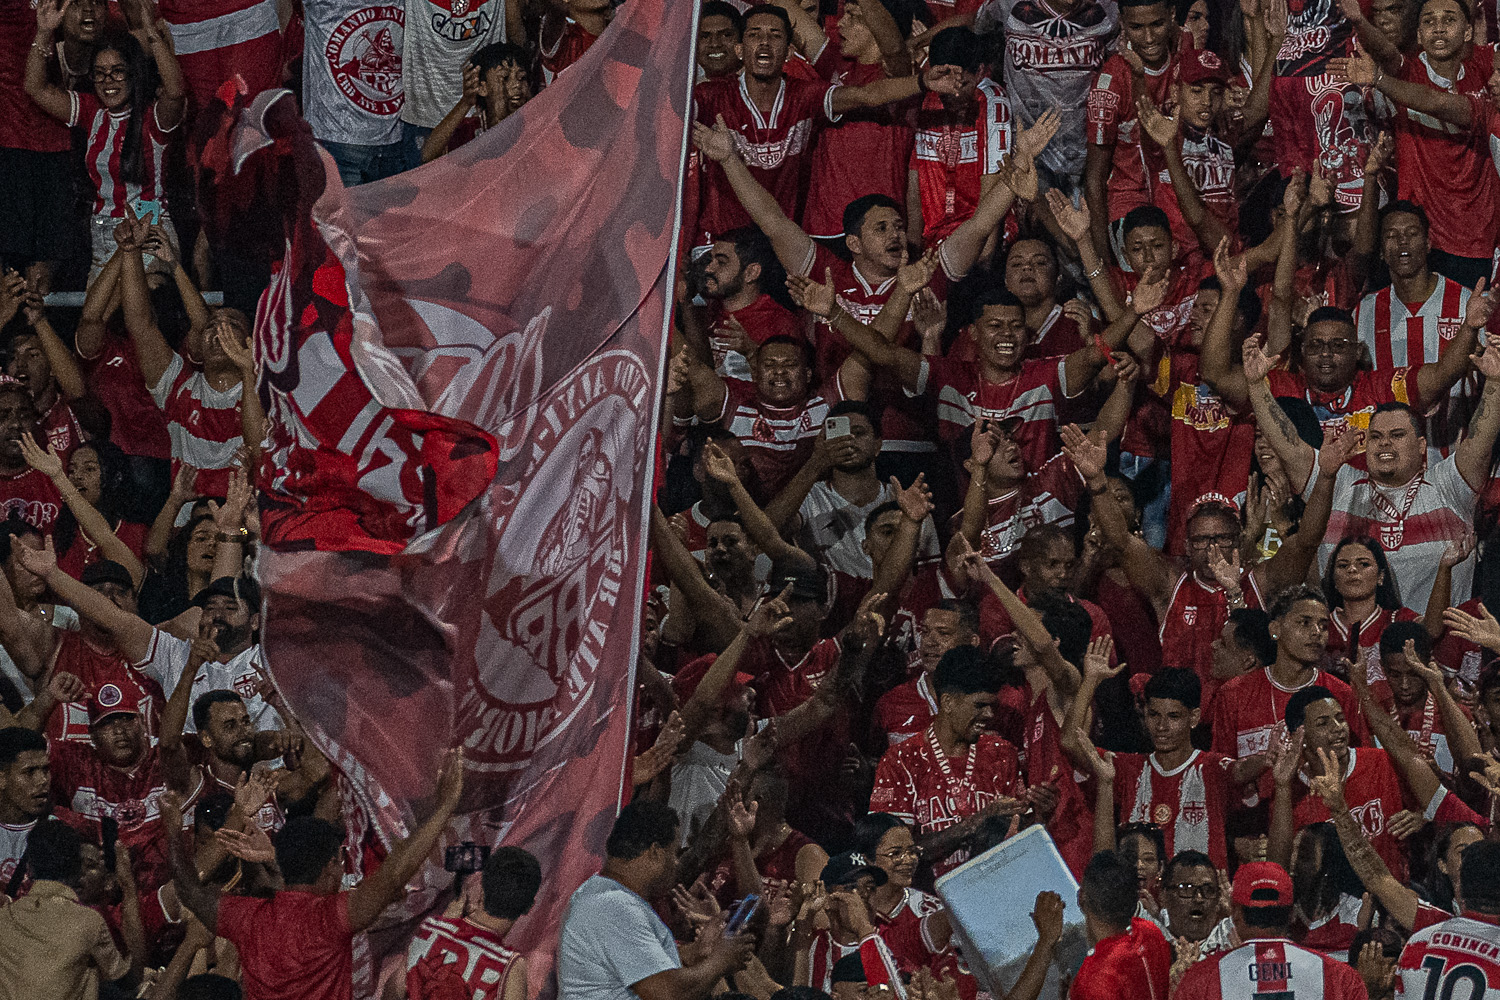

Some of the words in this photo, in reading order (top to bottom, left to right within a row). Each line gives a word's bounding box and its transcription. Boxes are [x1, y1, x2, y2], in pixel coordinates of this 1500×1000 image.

[326, 8, 376, 63] COMANDO
[432, 12, 491, 41] CAIXA
[1431, 932, 1500, 960] CORINGA
[1248, 962, 1293, 982] GENI
[1418, 955, 1487, 1000] 10
